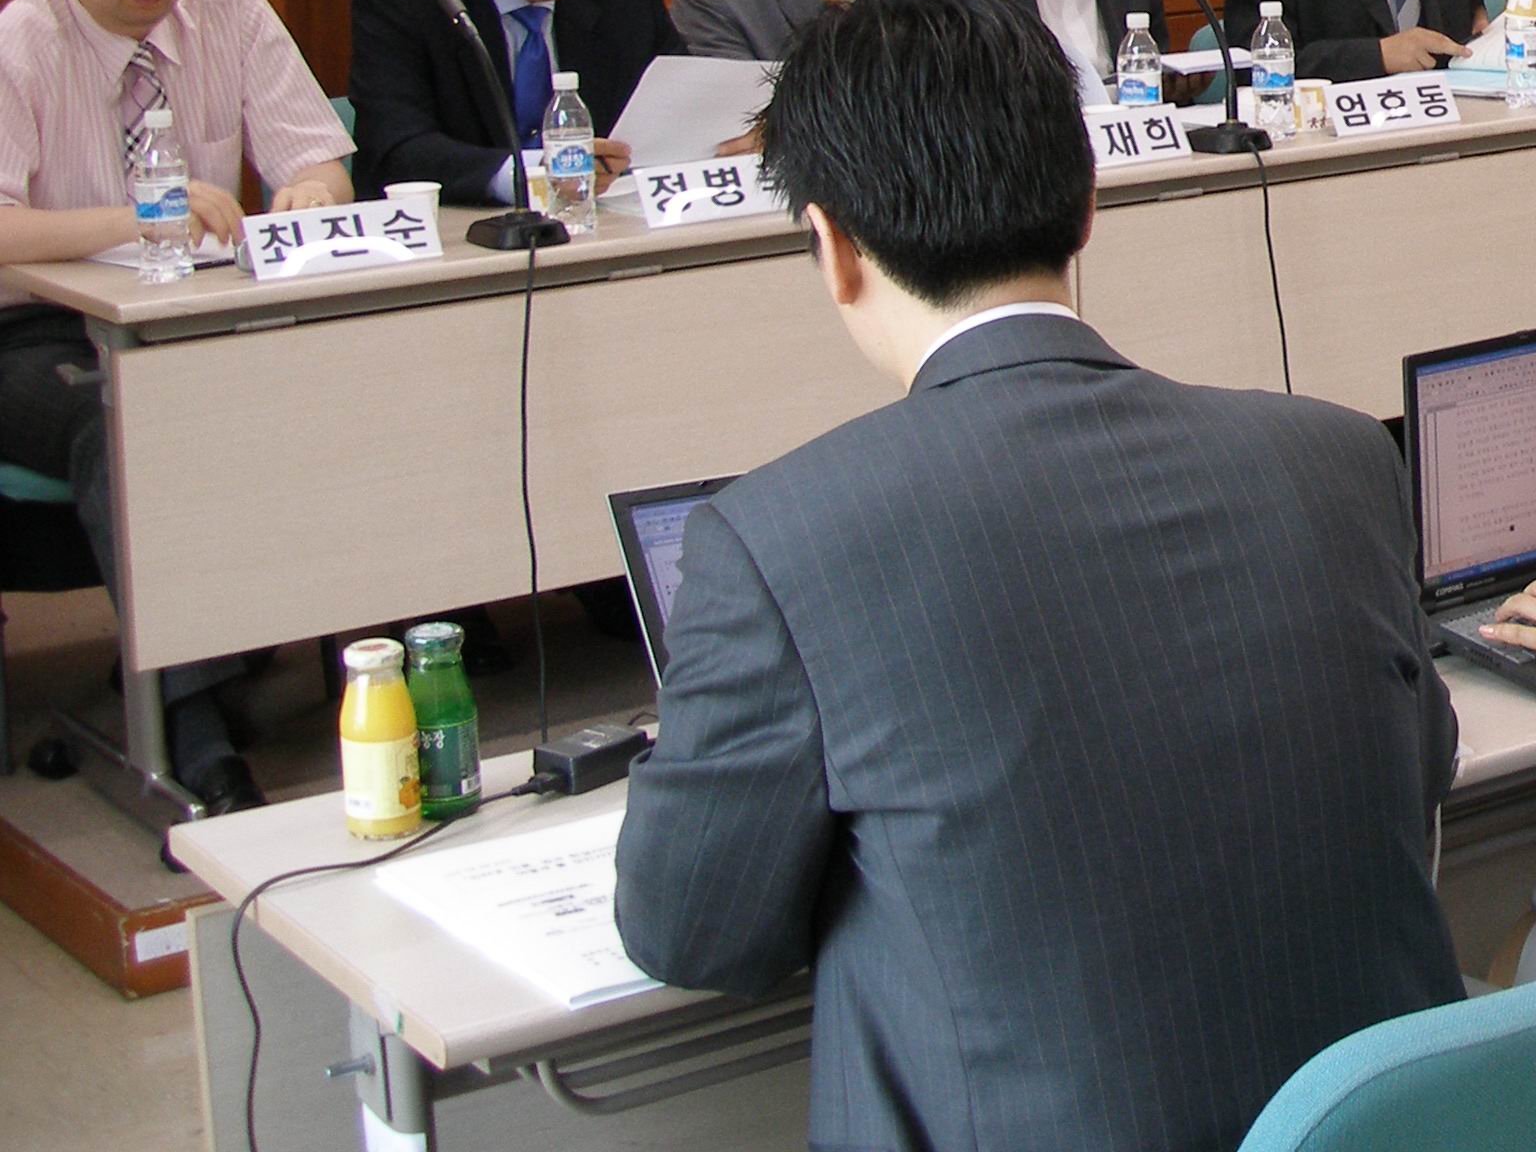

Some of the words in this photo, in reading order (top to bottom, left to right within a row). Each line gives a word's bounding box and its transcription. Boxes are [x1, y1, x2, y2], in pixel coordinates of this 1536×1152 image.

[1100, 116, 1181, 157] 재희
[648, 164, 775, 213] 정병
[259, 209, 428, 264] 최진순
